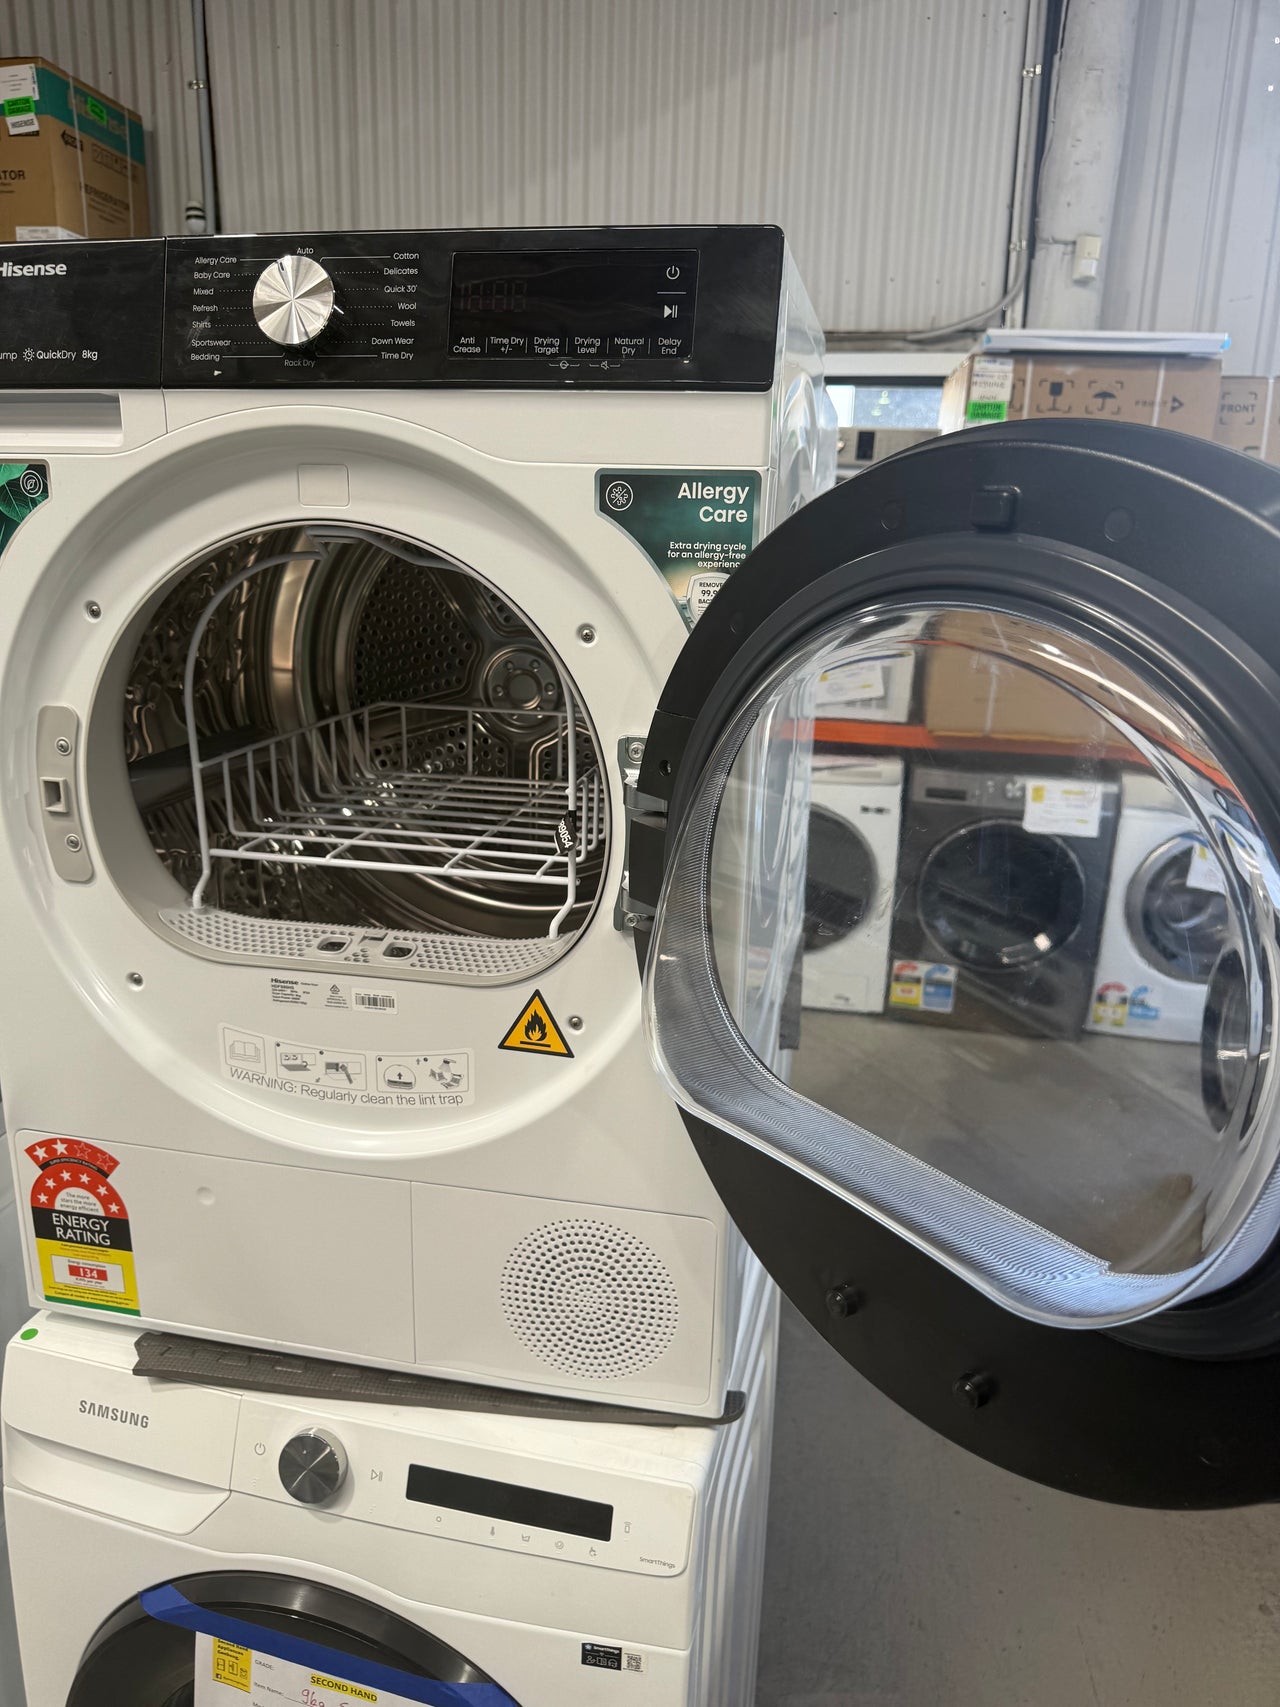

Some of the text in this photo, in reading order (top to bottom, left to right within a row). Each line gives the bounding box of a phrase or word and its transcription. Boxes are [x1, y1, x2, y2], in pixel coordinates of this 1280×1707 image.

[0, 169, 26, 180] TOR
[296, 247, 314, 255] Auto
[393, 252, 420, 260] Cotton
[194, 256, 238, 266] Allergy Care
[0, 261, 68, 278] Hisense
[383, 267, 419, 275] Delicates
[193, 271, 231, 280] Baby Care
[193, 287, 215, 296] Mixed
[383, 285, 405, 293] Quick
[192, 304, 219, 312] Refresh
[397, 302, 417, 310] Wool
[192, 320, 212, 329] Shirts
[390, 319, 416, 327] Towels
[191, 338, 232, 348] Sportswear
[371, 337, 415, 345] Down Wear
[459, 336, 476, 345] Anti
[489, 336, 525, 347] Time Dry
[533, 336, 560, 347] Drying
[574, 336, 601, 347] Drying
[614, 337, 645, 345] Natural
[658, 337, 682, 347] Delay
[452, 345, 481, 354] Crease
[533, 345, 560, 356] Target
[577, 346, 598, 355] Level
[621, 346, 636, 357] Dry
[661, 347, 677, 355] End
[36, 350, 98, 361] QuickDry 8kg
[190, 353, 220, 362] Bedding
[380, 351, 414, 361] Time Dry
[284, 359, 302, 367] Rack
[1220, 403, 1256, 413] FRONT
[677, 482, 750, 504] Allergy
[699, 506, 748, 523] Care
[669, 541, 747, 552] Extra drying cycle
[667, 549, 680, 558] for
[694, 550, 747, 561] allergy-free
[697, 559, 741, 570] experienc
[230, 1067, 464, 1106] WARNING: Regularly clean the lint trap
[52, 1213, 109, 1232] ENERGY
[55, 1227, 111, 1246] RATING
[79, 1267, 98, 1279] 134
[79, 1399, 149, 1428] SAMSUNG
[639, 1556, 676, 1569] SmartThings
[254, 1681, 267, 1690] Item
[310, 1675, 378, 1702] SECOND HAND
